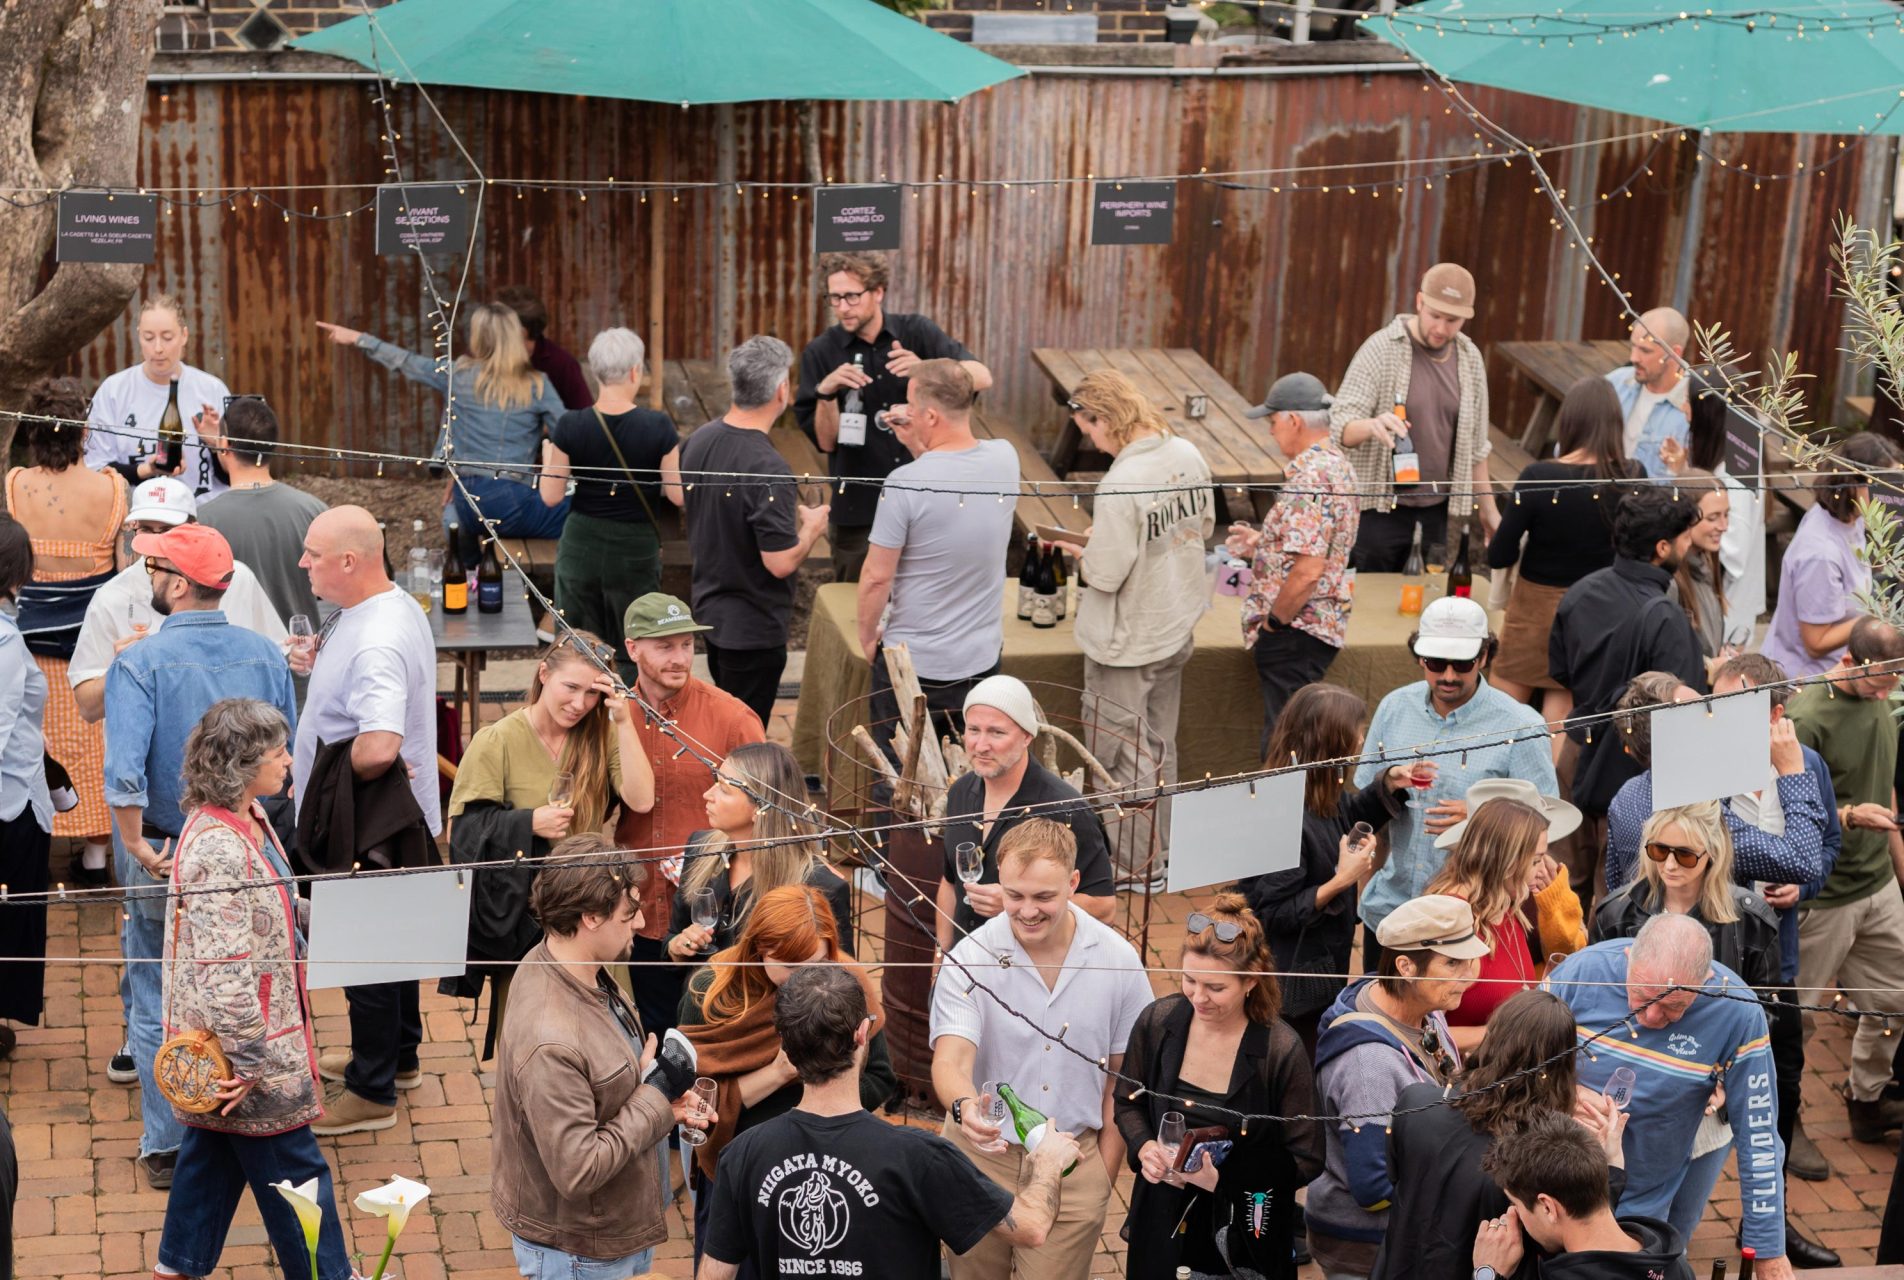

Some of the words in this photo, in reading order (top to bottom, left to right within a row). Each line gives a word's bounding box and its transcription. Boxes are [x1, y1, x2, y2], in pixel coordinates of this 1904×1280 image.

[1100, 201, 1145, 209] PERIPHERY
[1146, 200, 1168, 209] WINE
[841, 206, 876, 215] CORTEZ
[1115, 209, 1152, 217] IMPORTS
[75, 214, 107, 223] LIVING
[108, 215, 139, 224] WINES
[395, 215, 450, 225] SEECTIONS
[832, 215, 870, 224] TRADING
[870, 214, 885, 222] CO
[1190, 397, 1206, 417] 21
[1748, 1072, 1776, 1213] FLINDERS
[757, 1153, 818, 1207] NIIGATA
[821, 1154, 880, 1208] MYOKO
[778, 1257, 827, 1275] SINCE
[829, 1259, 863, 1276] 1966
